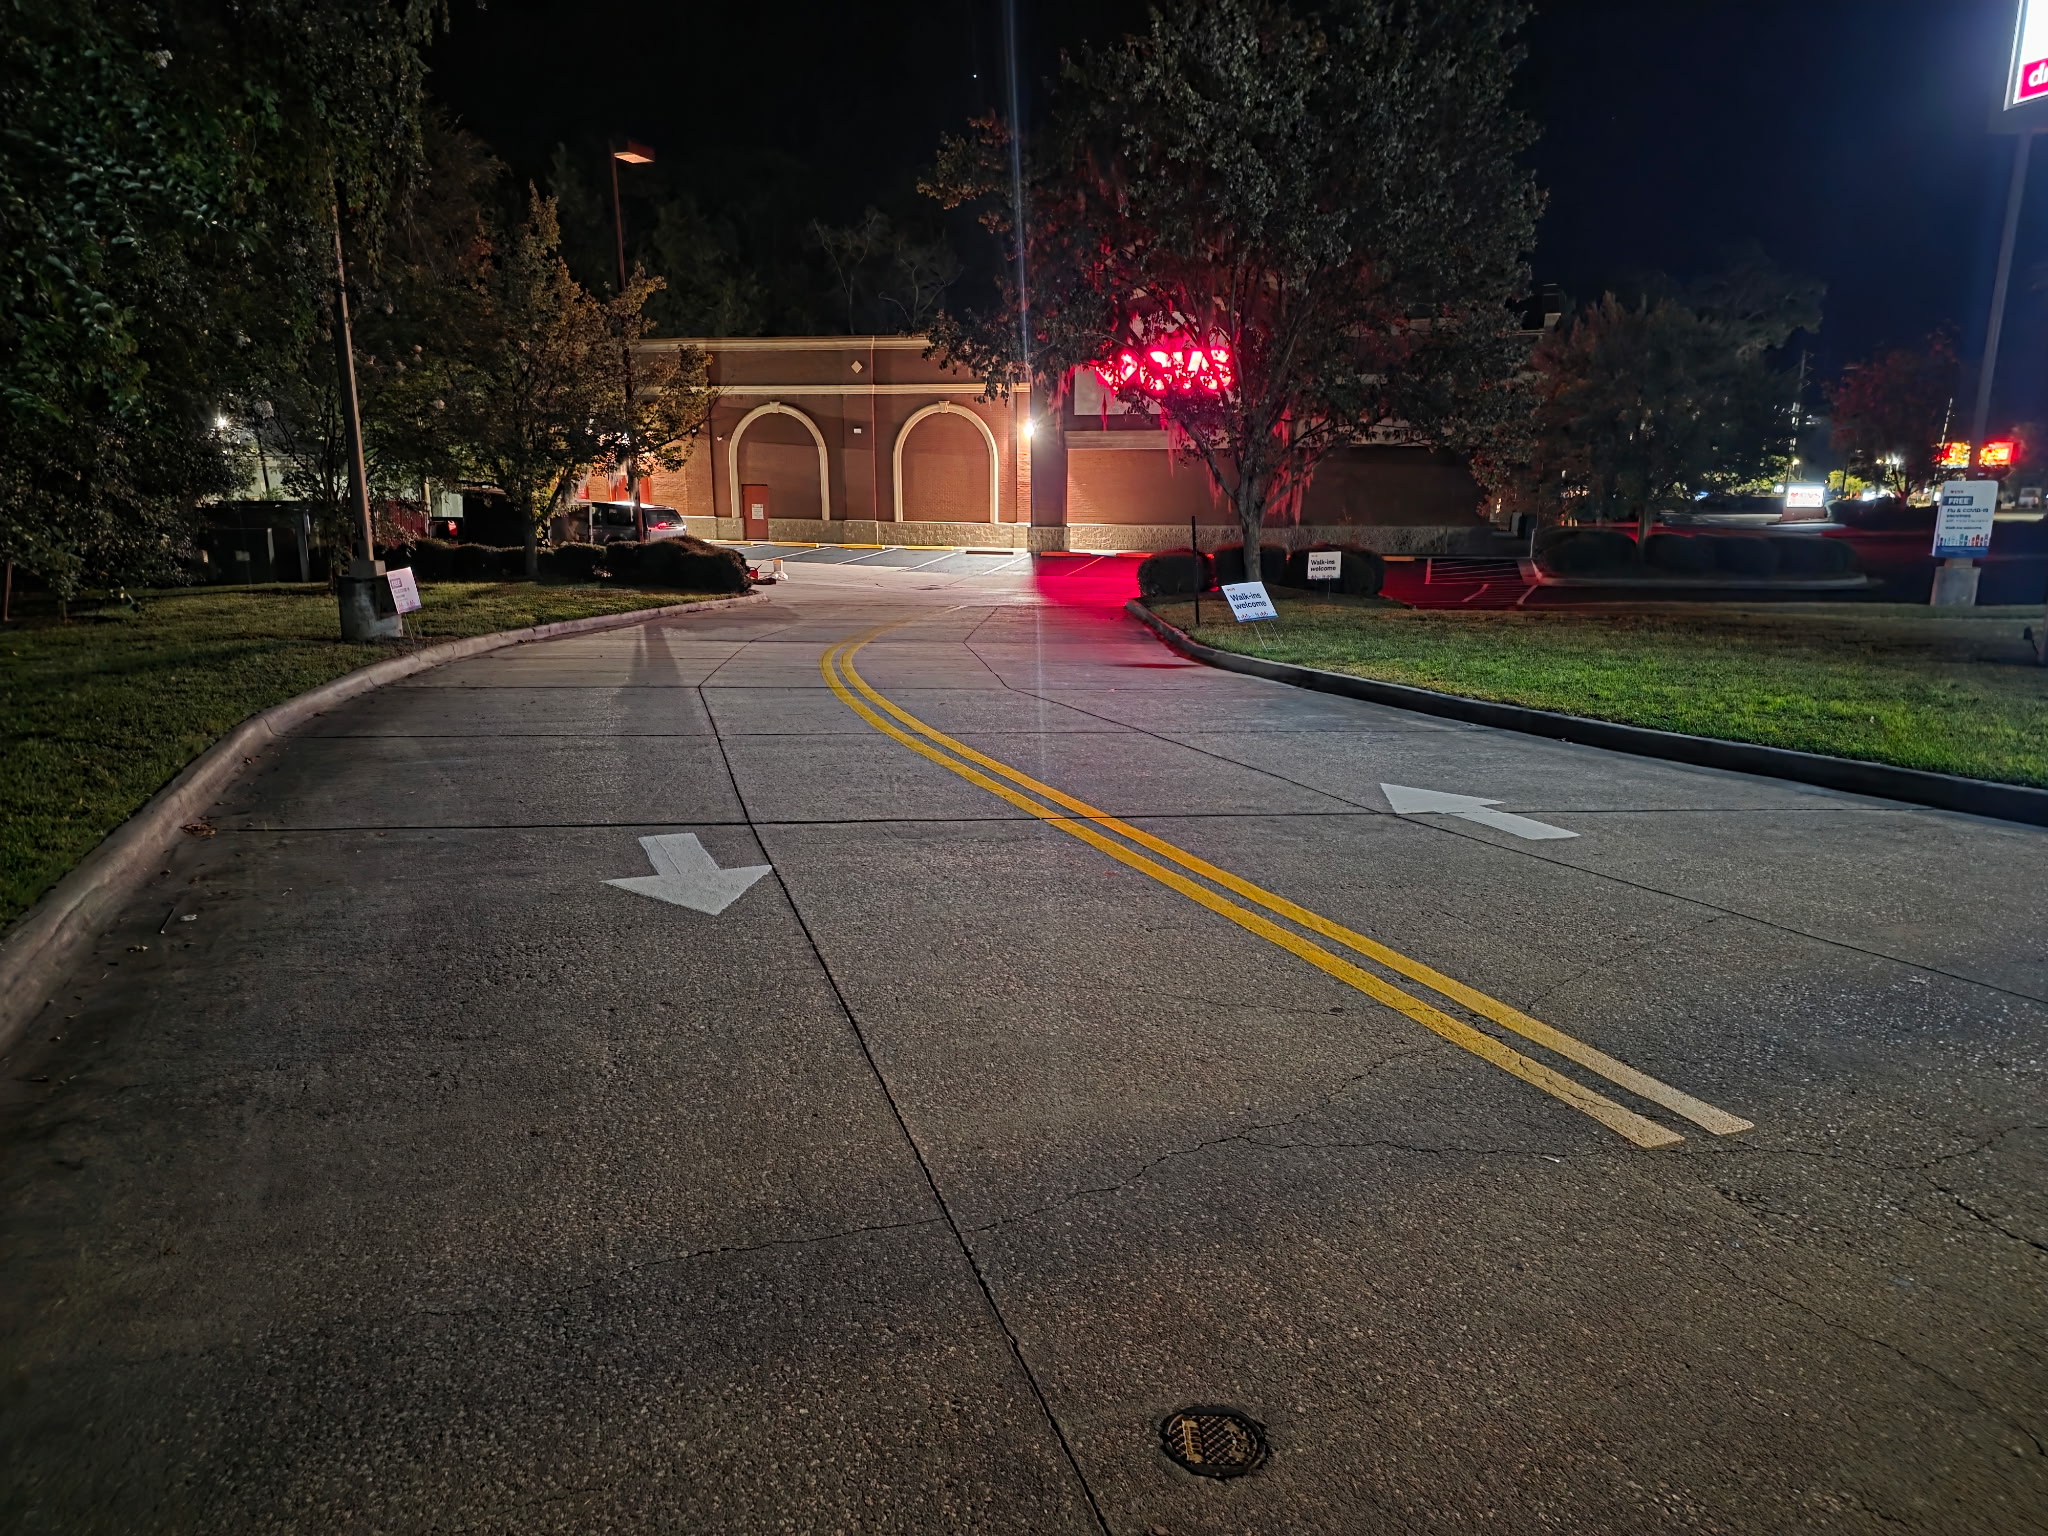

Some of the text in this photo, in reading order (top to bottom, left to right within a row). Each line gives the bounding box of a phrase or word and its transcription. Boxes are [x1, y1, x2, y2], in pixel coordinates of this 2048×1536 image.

[1948, 497, 1969, 505] FREE
[1229, 592, 1262, 601] Walk-ins
[1234, 601, 1267, 610] welcome
